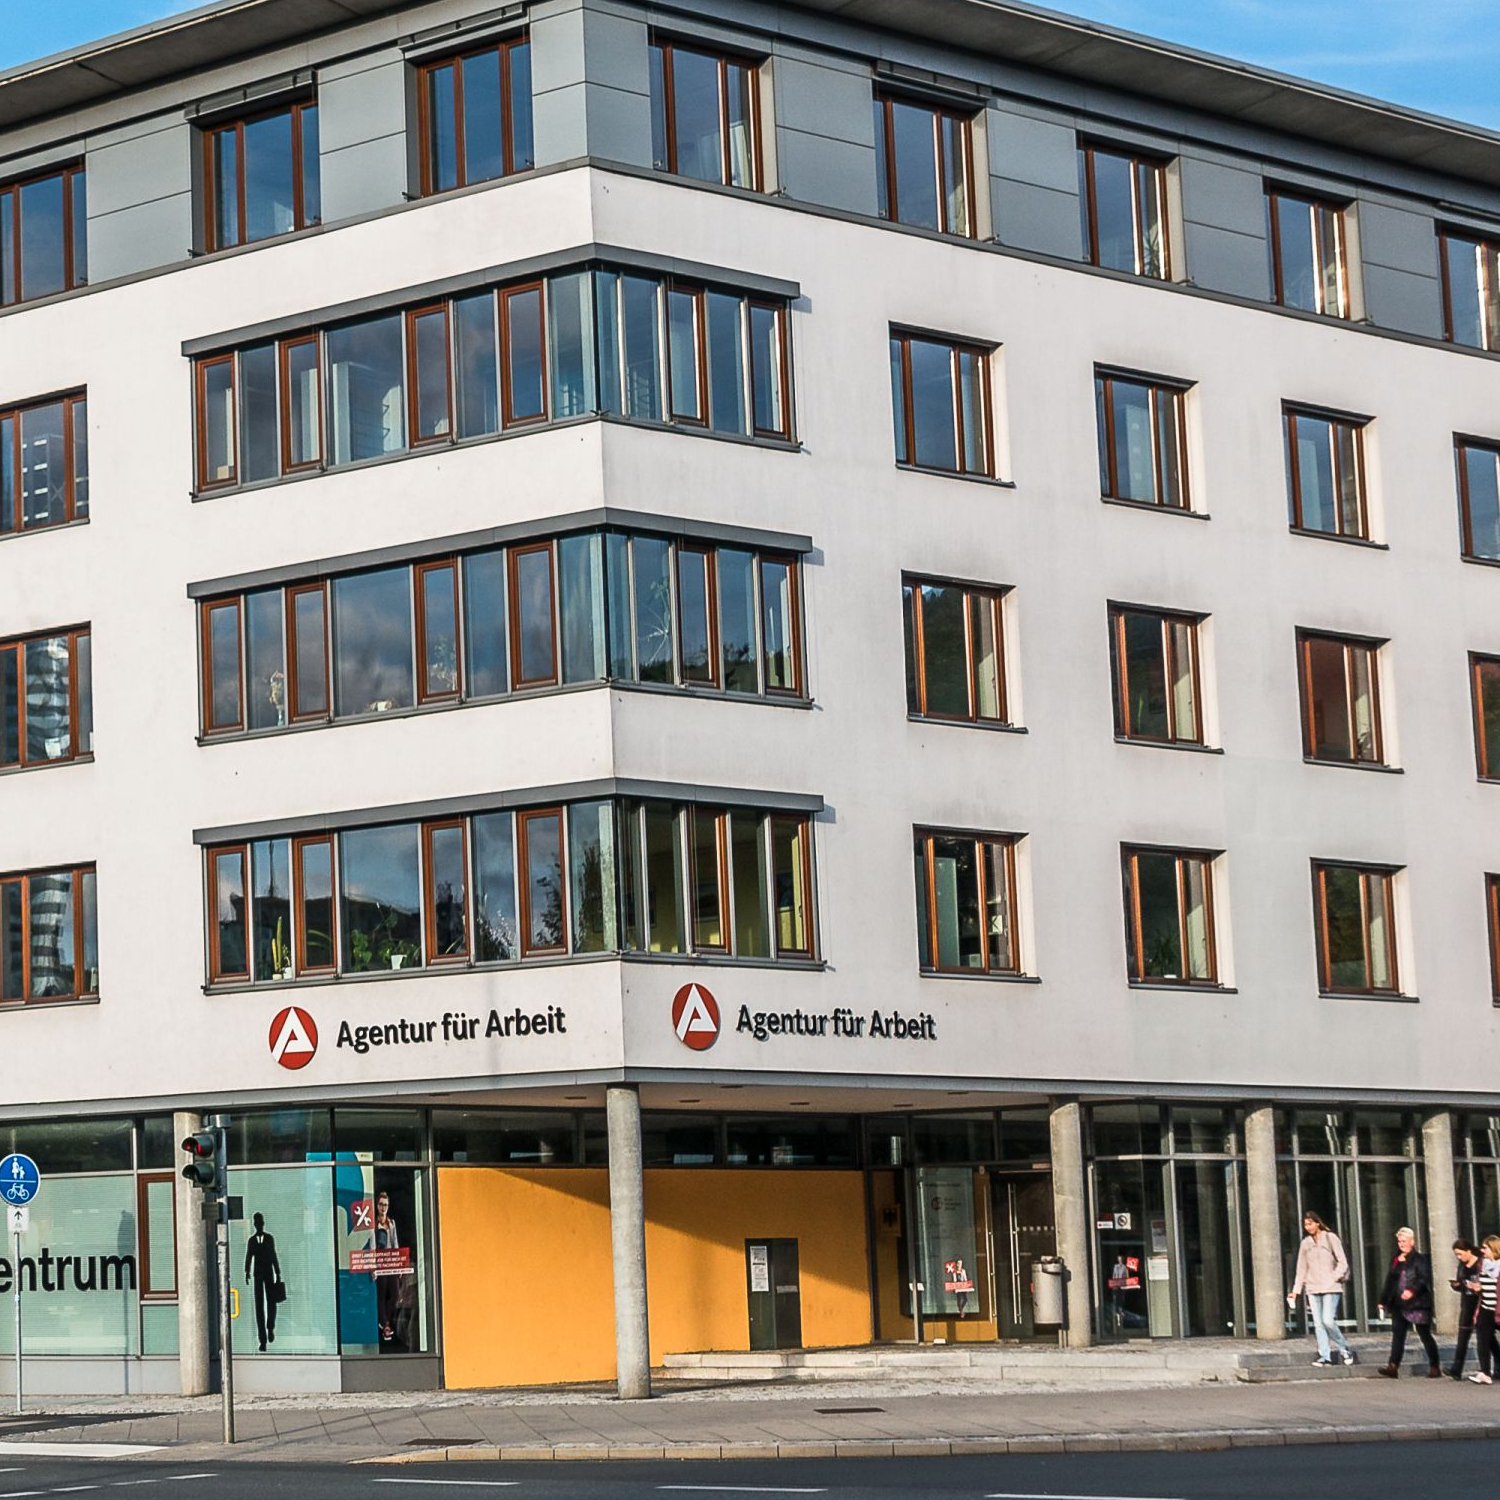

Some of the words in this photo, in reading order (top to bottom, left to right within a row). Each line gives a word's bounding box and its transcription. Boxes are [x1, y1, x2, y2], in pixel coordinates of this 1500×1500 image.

[337, 1018, 437, 1054] Agentur
[441, 1012, 480, 1041] für
[484, 1005, 567, 1038] Arbeit
[736, 1004, 829, 1042] Agentur
[831, 1008, 866, 1038] für
[869, 1010, 937, 1041] Arbeit
